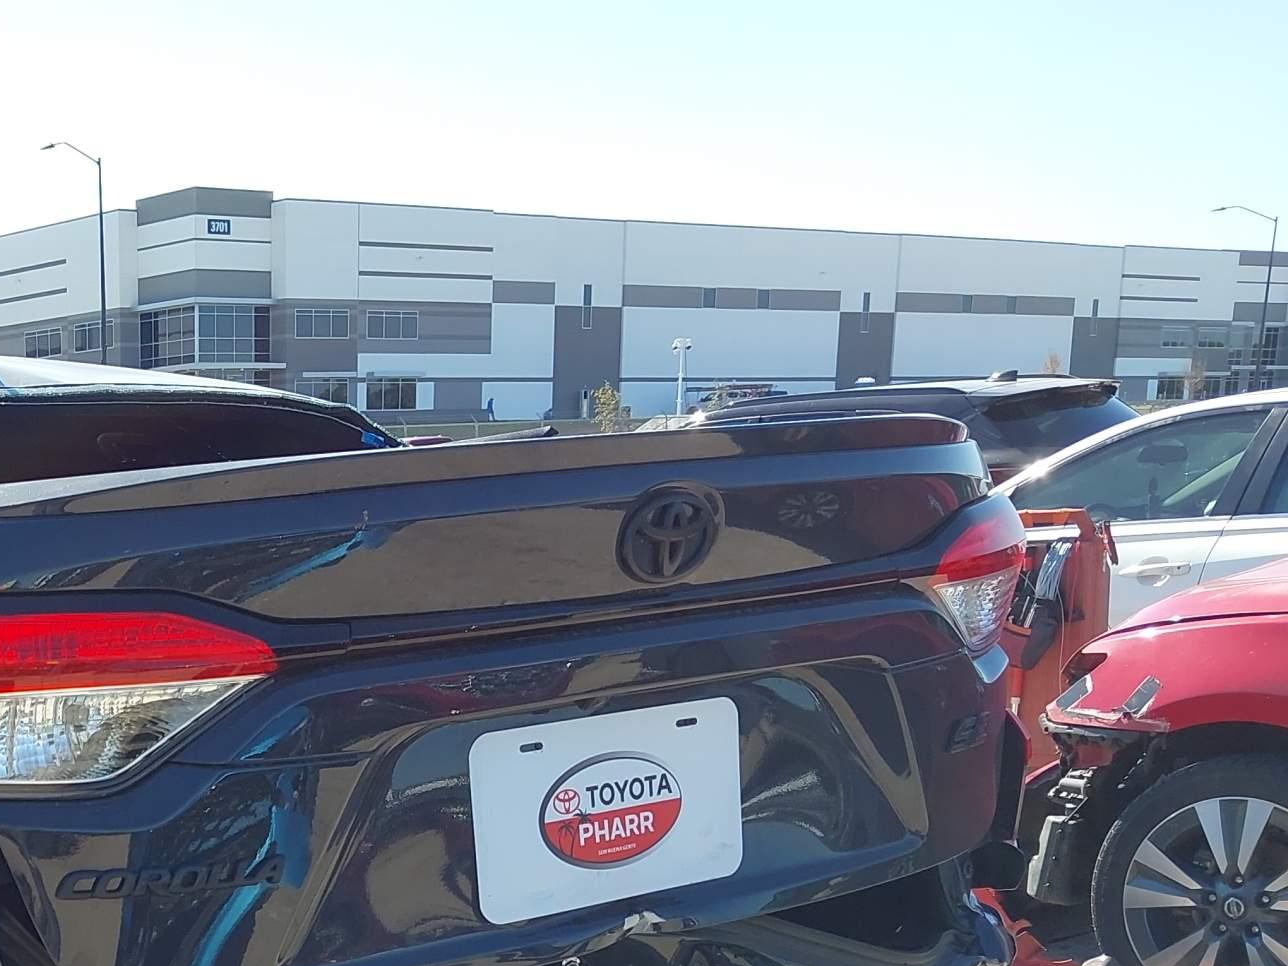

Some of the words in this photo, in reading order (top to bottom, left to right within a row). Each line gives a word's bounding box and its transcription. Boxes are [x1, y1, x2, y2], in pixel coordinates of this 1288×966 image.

[210, 221, 229, 233] 3701
[585, 773, 673, 809] TOYOTA
[578, 811, 655, 847] PHARR
[55, 853, 285, 900] COROLLA
